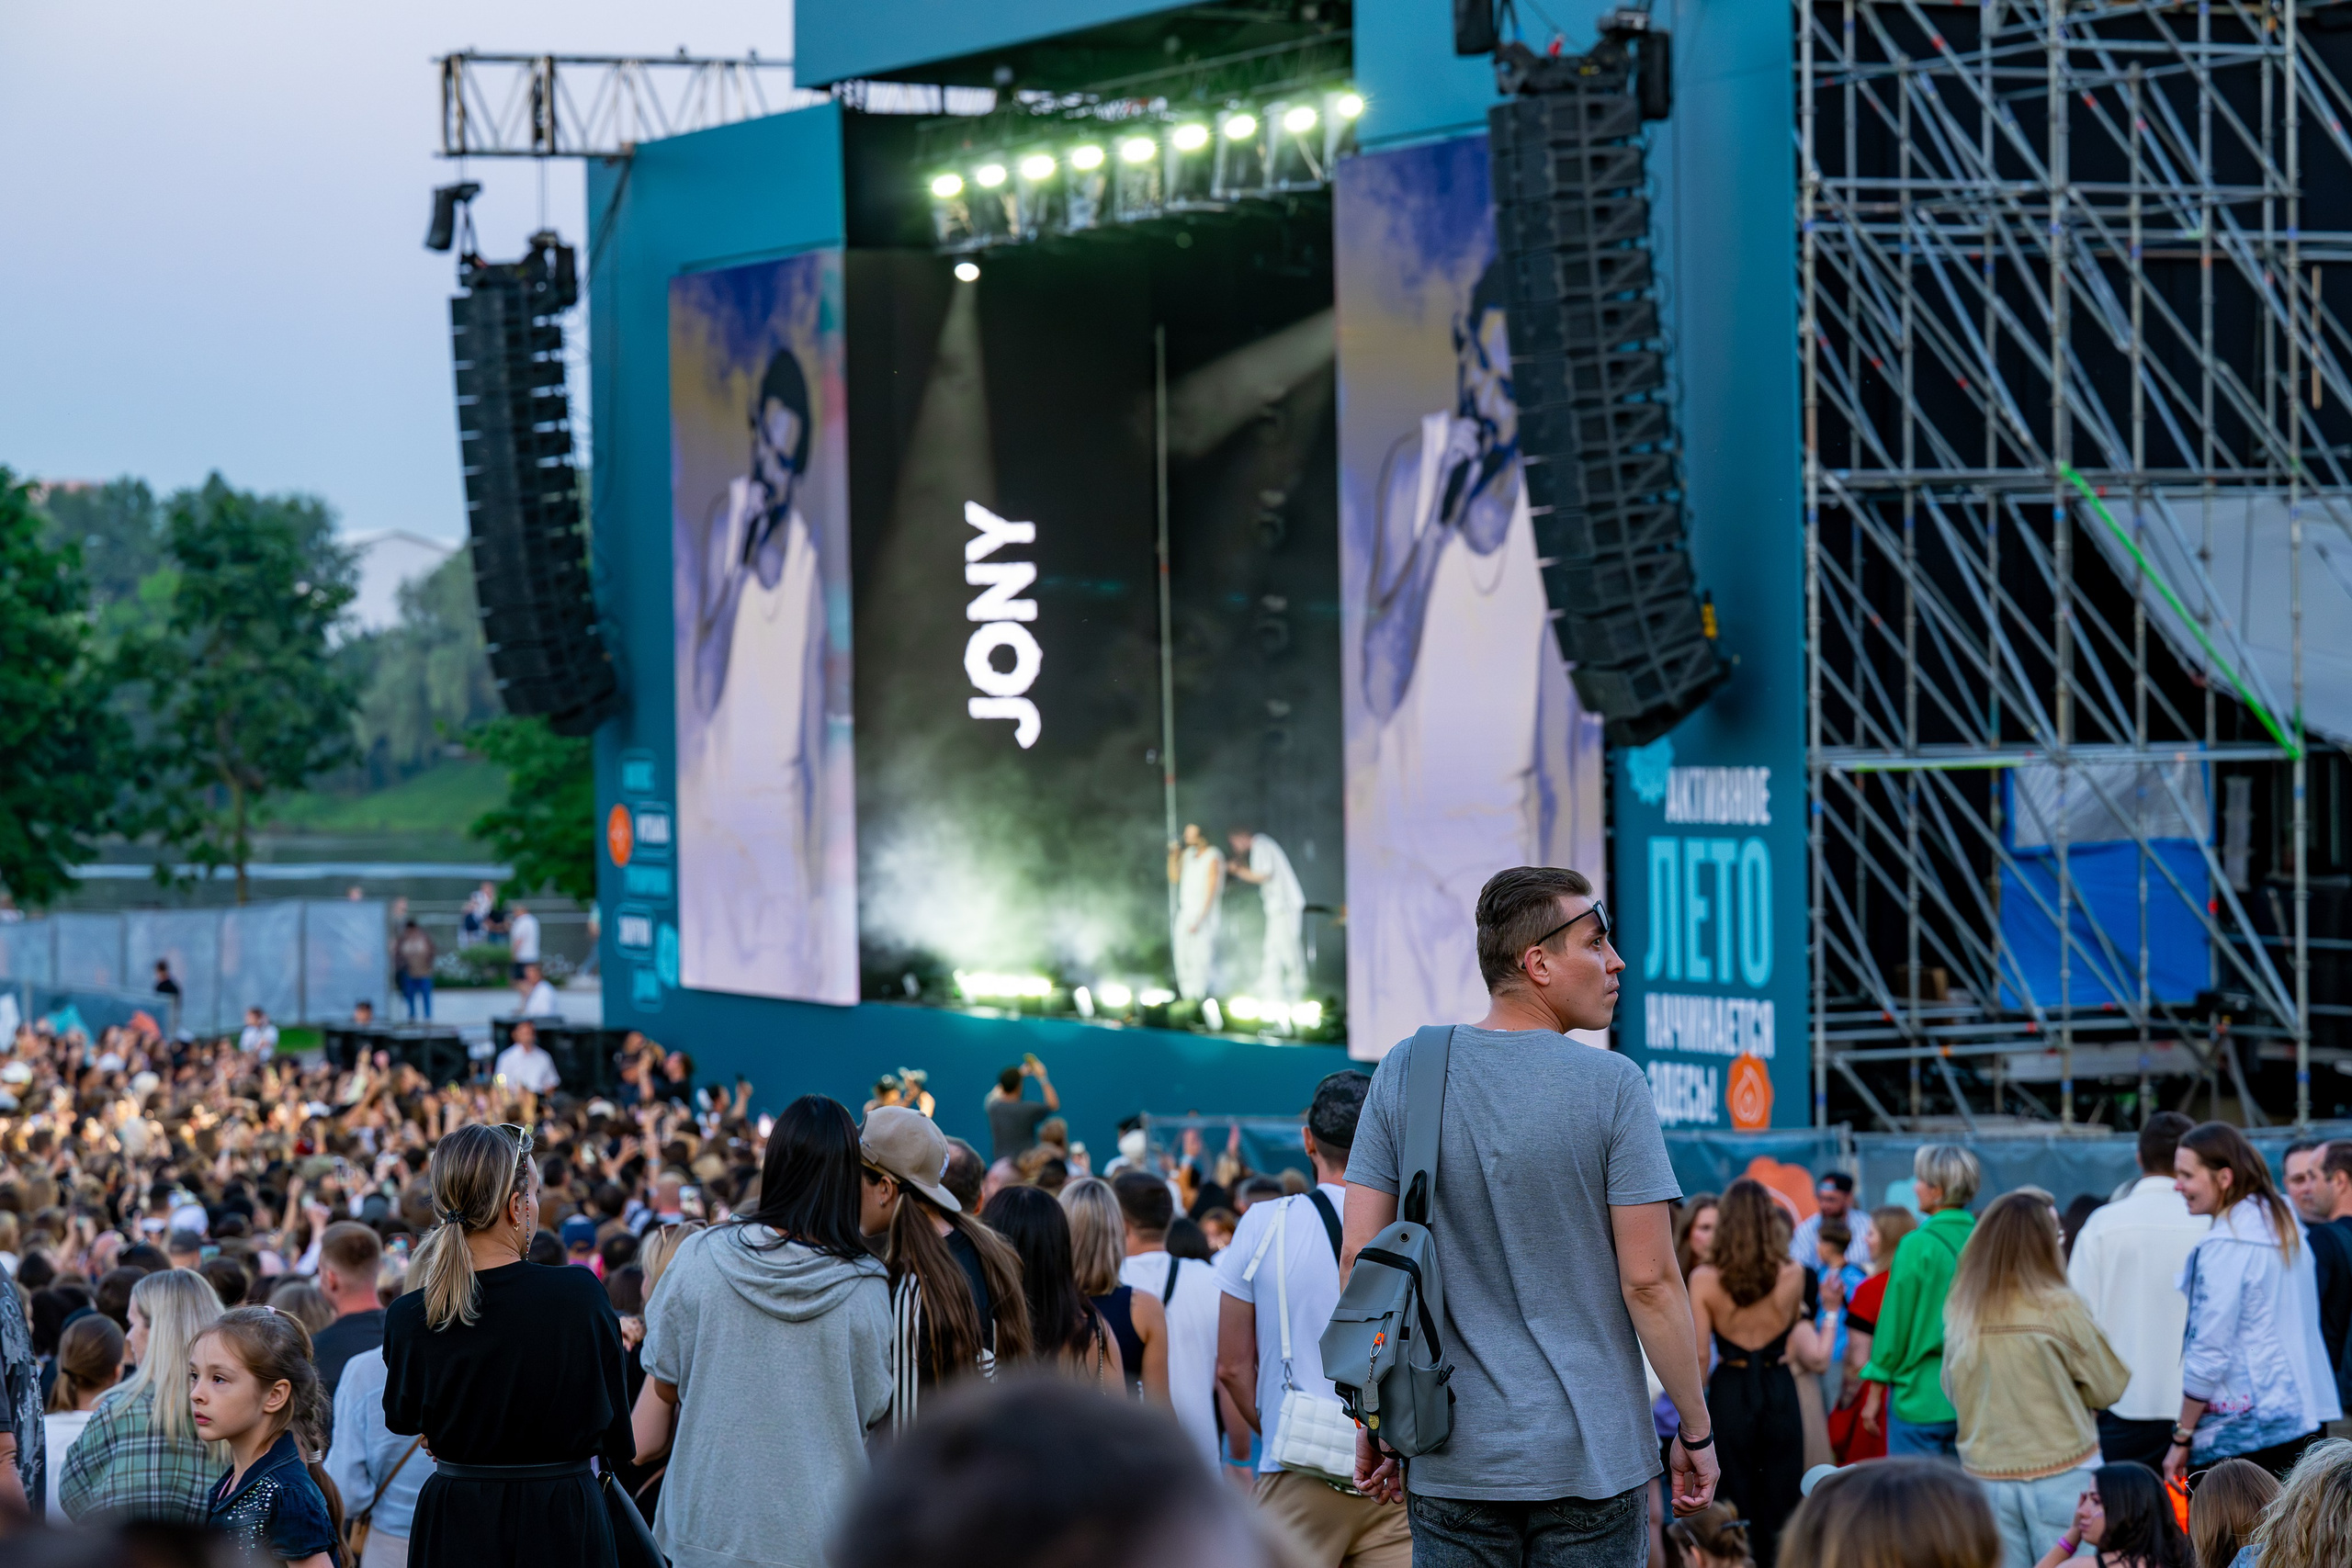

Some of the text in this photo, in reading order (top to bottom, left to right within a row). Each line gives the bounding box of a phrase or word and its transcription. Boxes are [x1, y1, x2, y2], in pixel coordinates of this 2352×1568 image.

[964, 500, 1043, 749] JONY
[1665, 765, 1771, 826] АКТИВНОЕ
[1644, 836, 1773, 988] ЛЕТО
[1645, 992, 1775, 1059] НАЧИНАЕТСЯ
